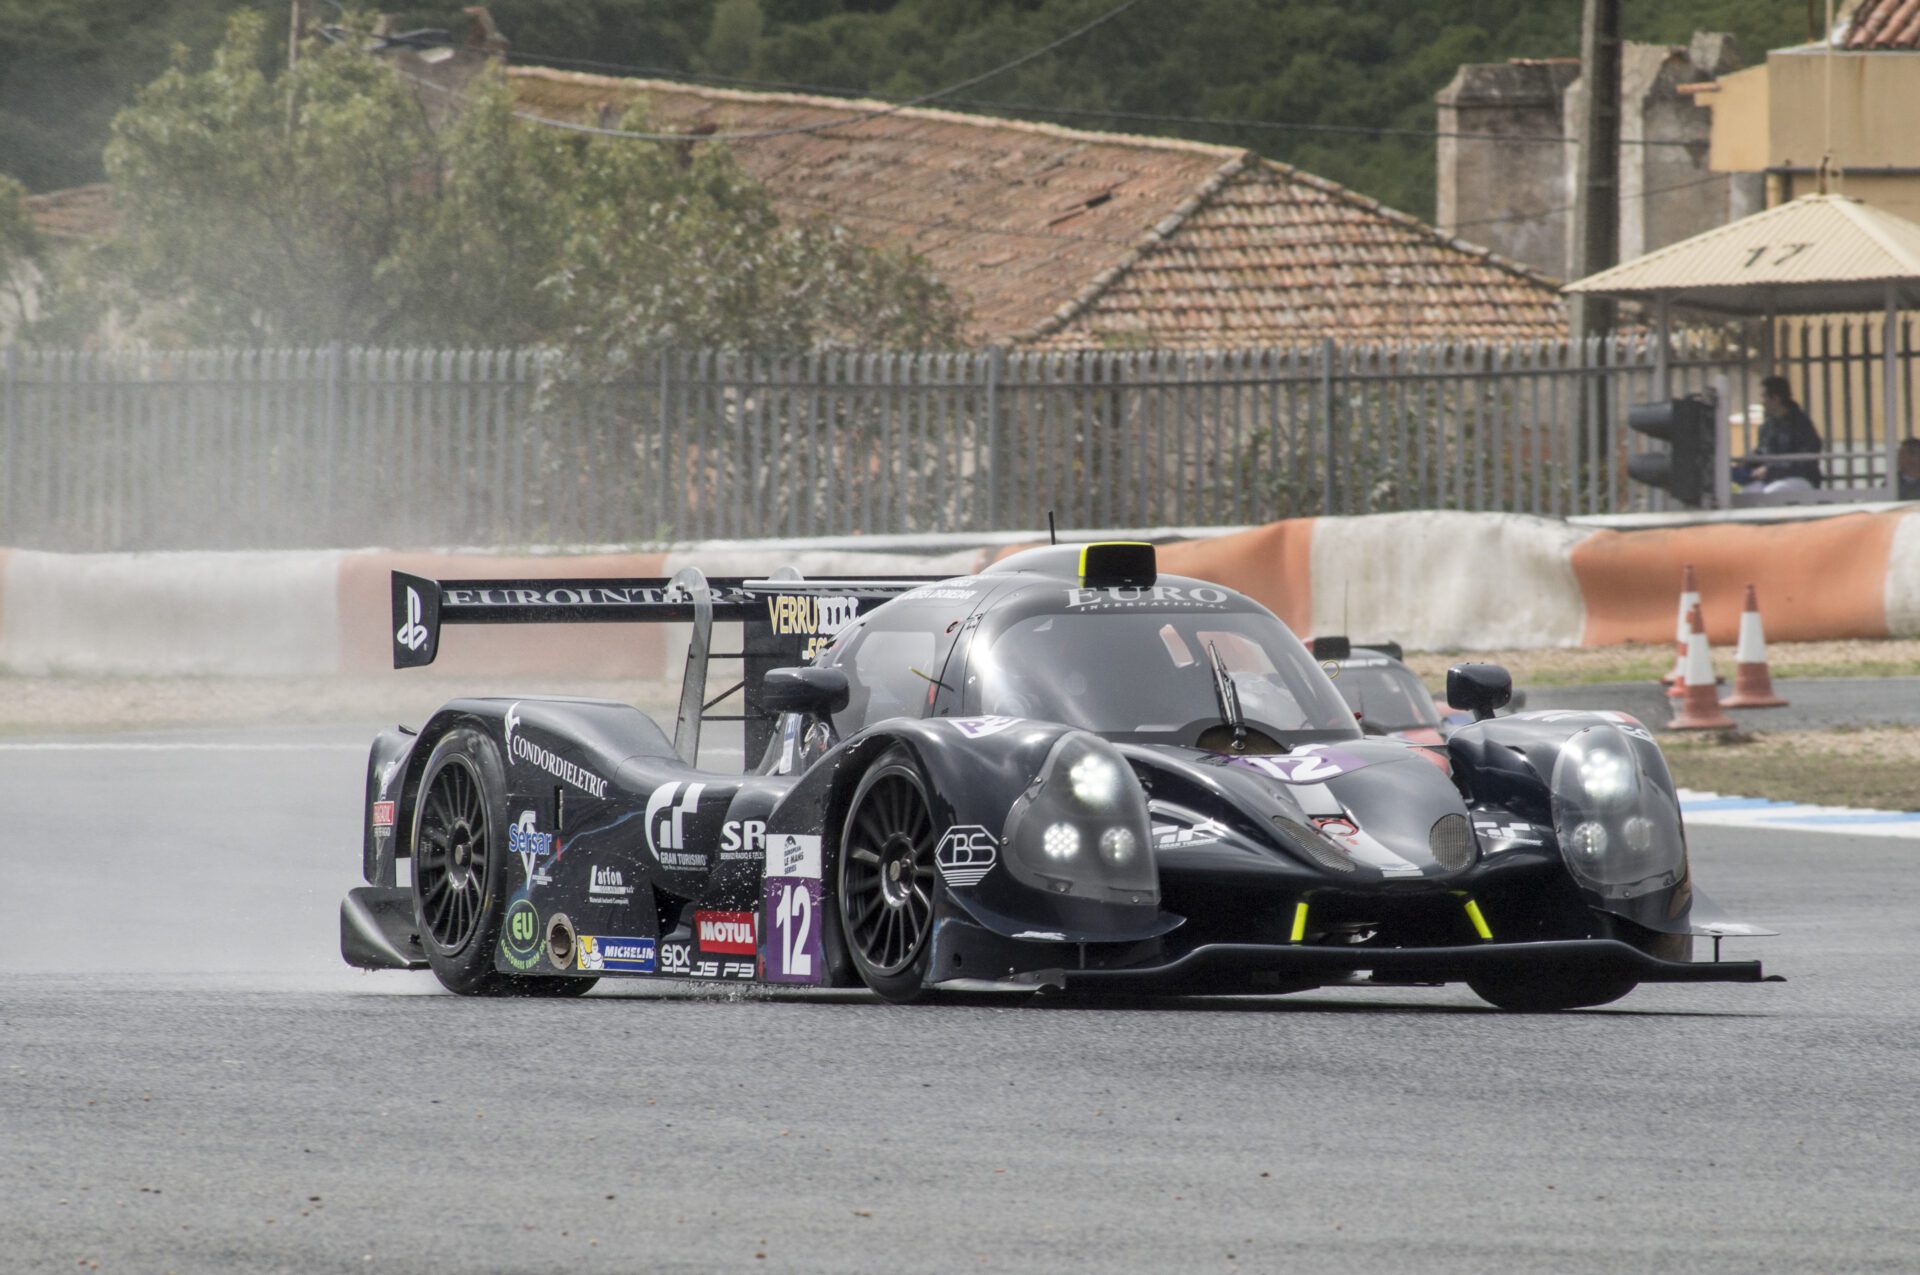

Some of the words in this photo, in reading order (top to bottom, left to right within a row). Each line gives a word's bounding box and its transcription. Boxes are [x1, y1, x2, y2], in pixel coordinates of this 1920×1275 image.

[1744, 243, 1815, 268] 17
[1064, 586, 1228, 608] EURO
[1080, 602, 1230, 611] INTERNATIONAL
[512, 735, 608, 800] CONDORDIELETRIC
[509, 822, 552, 856] Sersar
[660, 852, 677, 865] GRAN
[790, 852, 804, 865] MANS
[512, 912, 533, 940] EU
[701, 921, 754, 944] MOTUL
[776, 885, 811, 976] 12
[604, 945, 654, 960] MICHELIN
[690, 962, 718, 977] JS
[722, 962, 755, 978] P3
